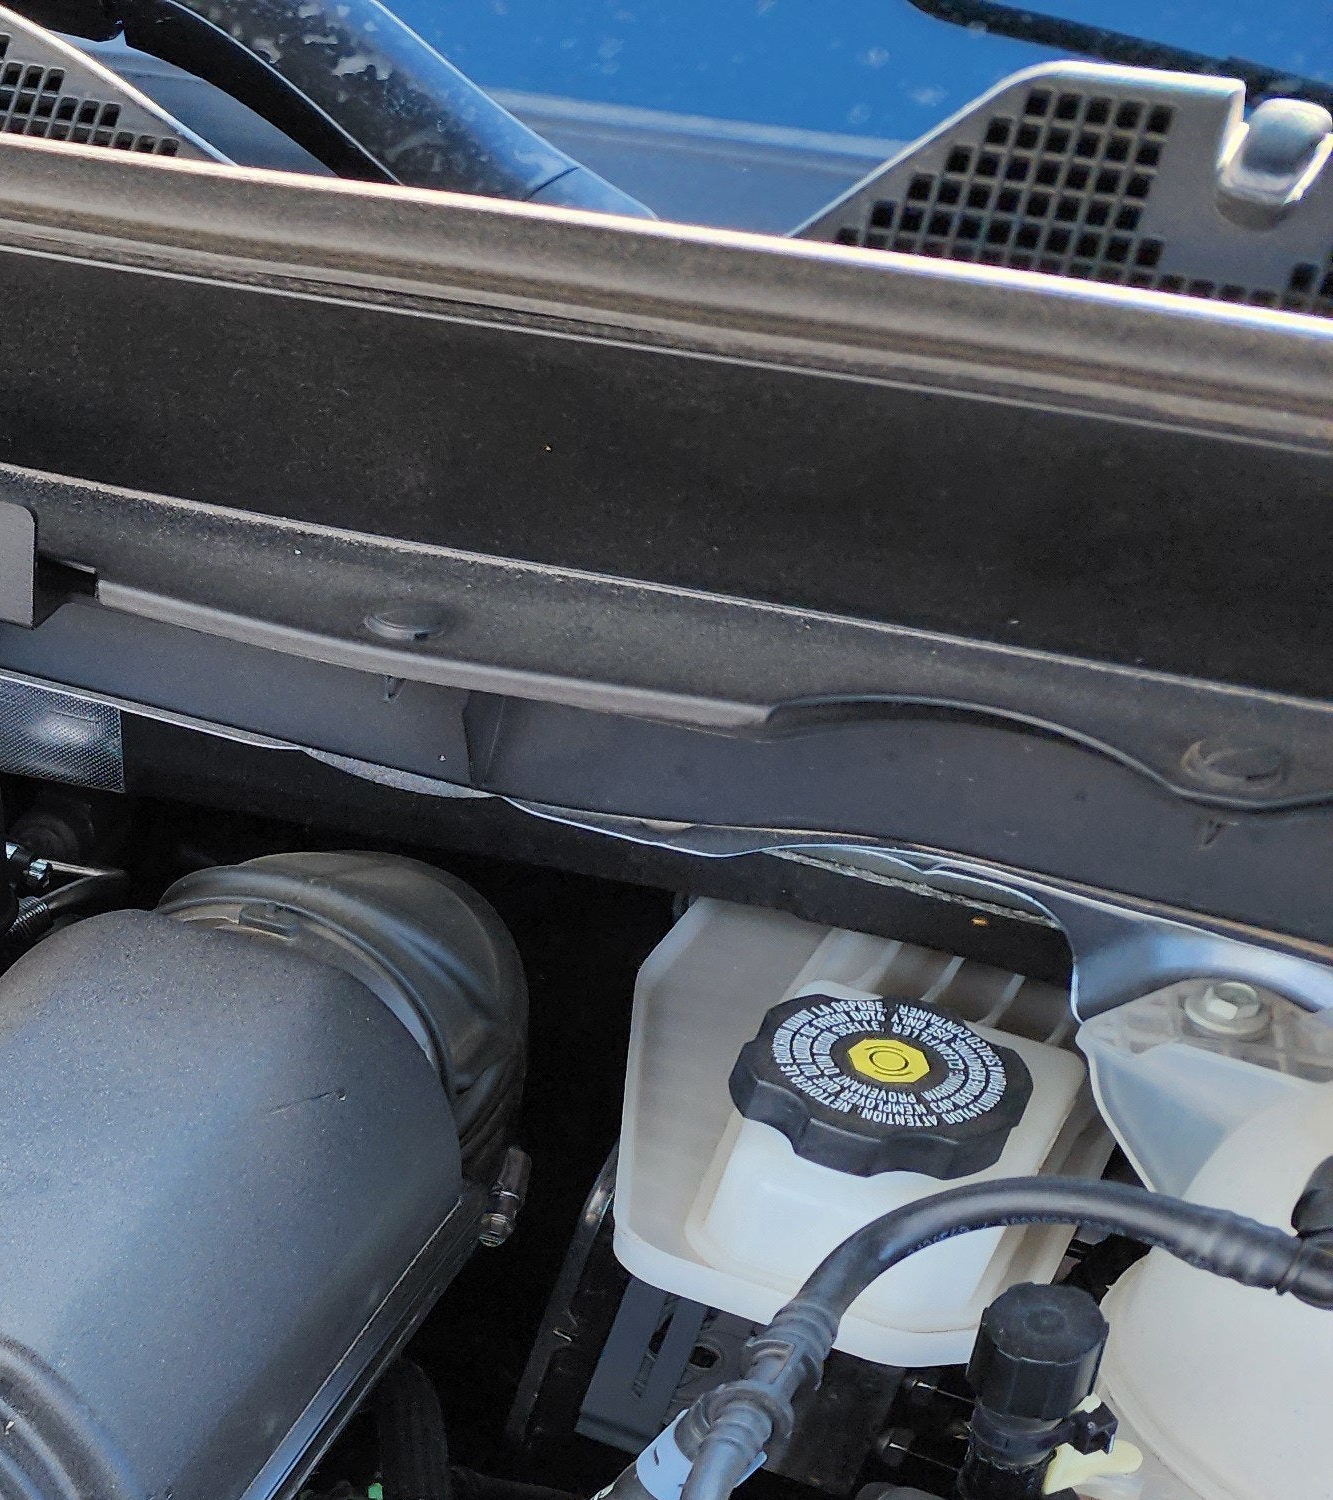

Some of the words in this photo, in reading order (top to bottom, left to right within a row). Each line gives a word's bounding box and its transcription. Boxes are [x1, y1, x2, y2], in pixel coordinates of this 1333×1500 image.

[783, 1010, 815, 1030] AVANT
[811, 1005, 833, 1015] LA
[850, 1011, 885, 1021] DOT4
[800, 1025, 820, 1037] DE
[813, 1013, 849, 1029] FREIN
[891, 1014, 926, 1029] ONLY
[892, 1023, 939, 1045] FILLER
[926, 1025, 953, 1040] USE
[772, 1029, 798, 1062] BOUCHON
[793, 1035, 816, 1063] LIQUIDE
[813, 1032, 838, 1054] BIDON
[966, 1037, 1001, 1065] SEALED
[815, 1056, 839, 1075] D'UN
[934, 1044, 964, 1069] CLEAN
[780, 1065, 800, 1075] LE
[800, 1065, 821, 1076] DU
[814, 1078, 840, 1092] QUE
[833, 1076, 916, 1103] PROVENANT
[921, 1071, 965, 1101] WARNING:
[951, 1079, 984, 1106] BEFORE
[988, 1072, 1006, 1094] FROM
[791, 1076, 851, 1112] NETTOYER
[838, 1091, 926, 1114] N'EMPLOYER
[969, 1093, 1000, 1114] FLUID
[930, 1100, 955, 1112] CAP
[856, 1108, 939, 1126] ATTENTION:
